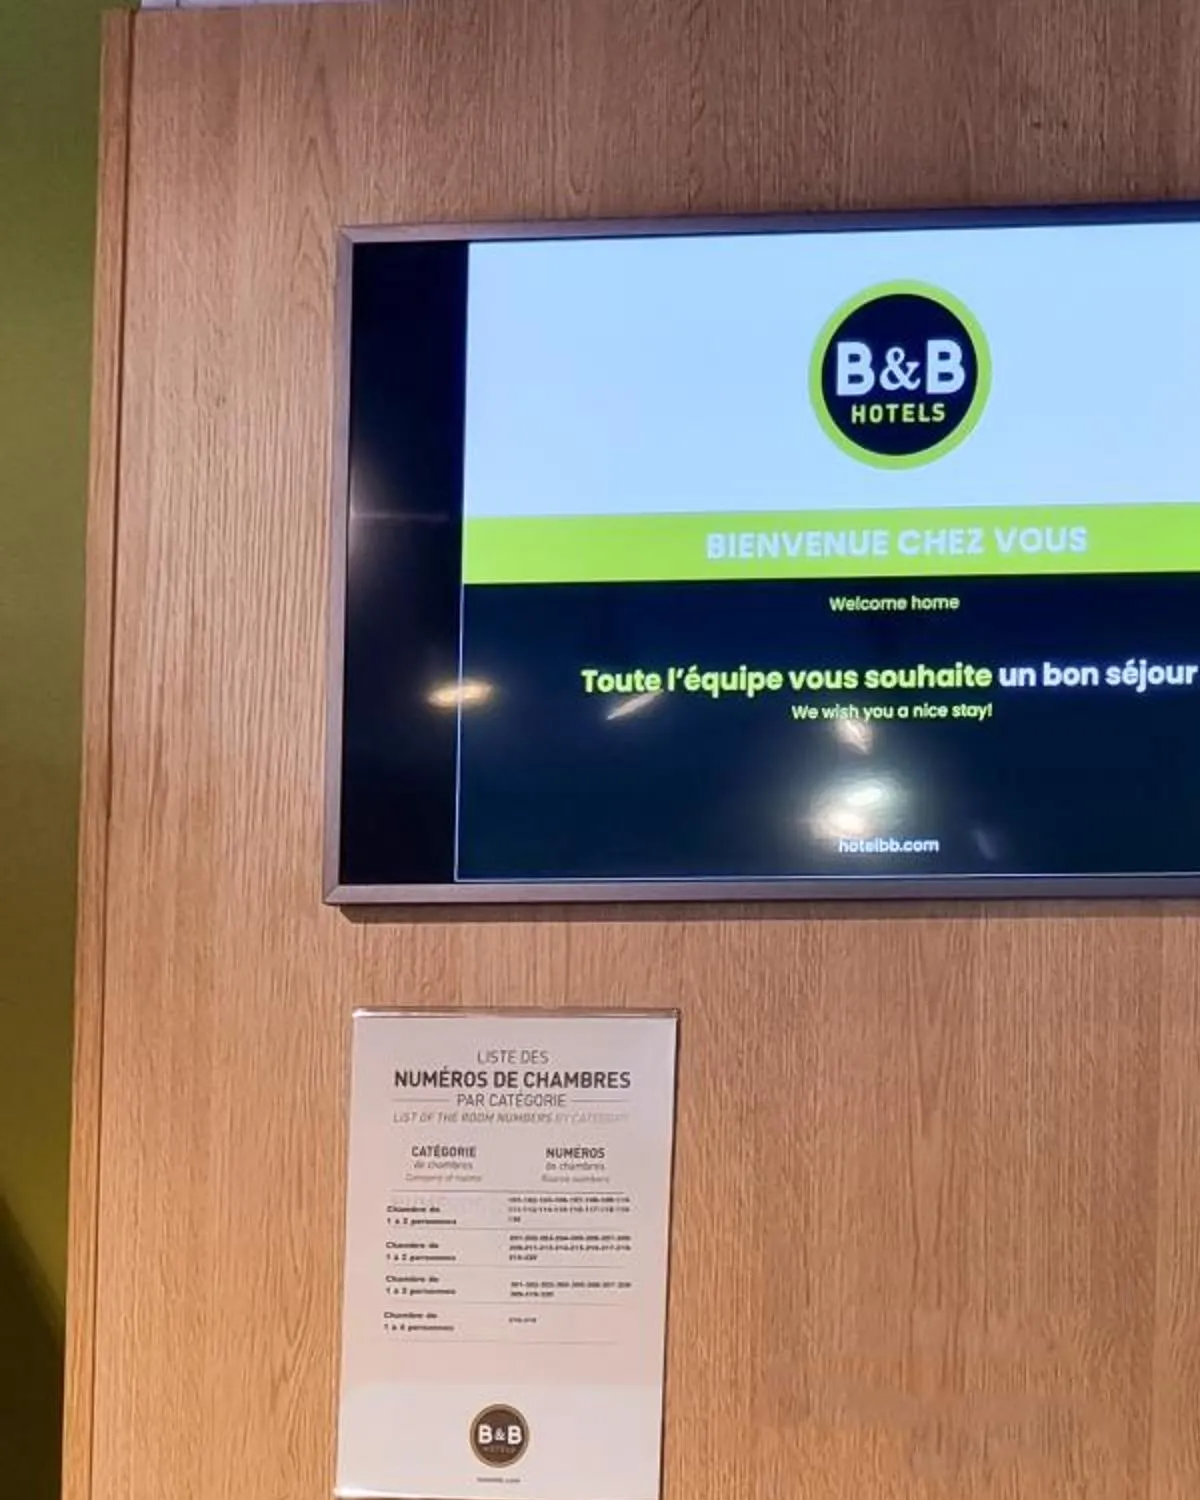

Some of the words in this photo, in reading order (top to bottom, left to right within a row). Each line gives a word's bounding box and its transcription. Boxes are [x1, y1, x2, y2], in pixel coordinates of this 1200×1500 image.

[835, 338, 966, 397] B&B
[850, 402, 946, 424] HOTELS
[706, 529, 889, 559] BIENVENUE
[897, 527, 984, 555] CHEZ
[993, 525, 1088, 553] VOUS
[829, 595, 907, 612] Welcome
[911, 594, 960, 611] home
[581, 668, 662, 693] Toute
[788, 669, 859, 690] vous
[863, 661, 993, 690] souhaite
[999, 665, 1036, 687] un
[1043, 661, 1099, 686] bon
[792, 704, 819, 720] We
[821, 704, 858, 720] wish
[862, 705, 895, 721] you
[897, 706, 909, 718] a
[912, 703, 948, 718] nice
[951, 702, 993, 721] stay!
[838, 837, 940, 853] hotelbb.com
[477, 1050, 517, 1064] LISTE
[521, 1049, 549, 1064] DES
[394, 1066, 489, 1088] NUMÉROS
[493, 1071, 518, 1088] DE
[523, 1071, 631, 1089] CHAMBRES
[457, 1093, 486, 1107] PAR
[489, 1090, 567, 1108] CATÉGORIE
[411, 1145, 477, 1158] CATÉGORIE
[545, 1146, 605, 1159] NUMÉROS
[478, 1424, 523, 1445] B&B
